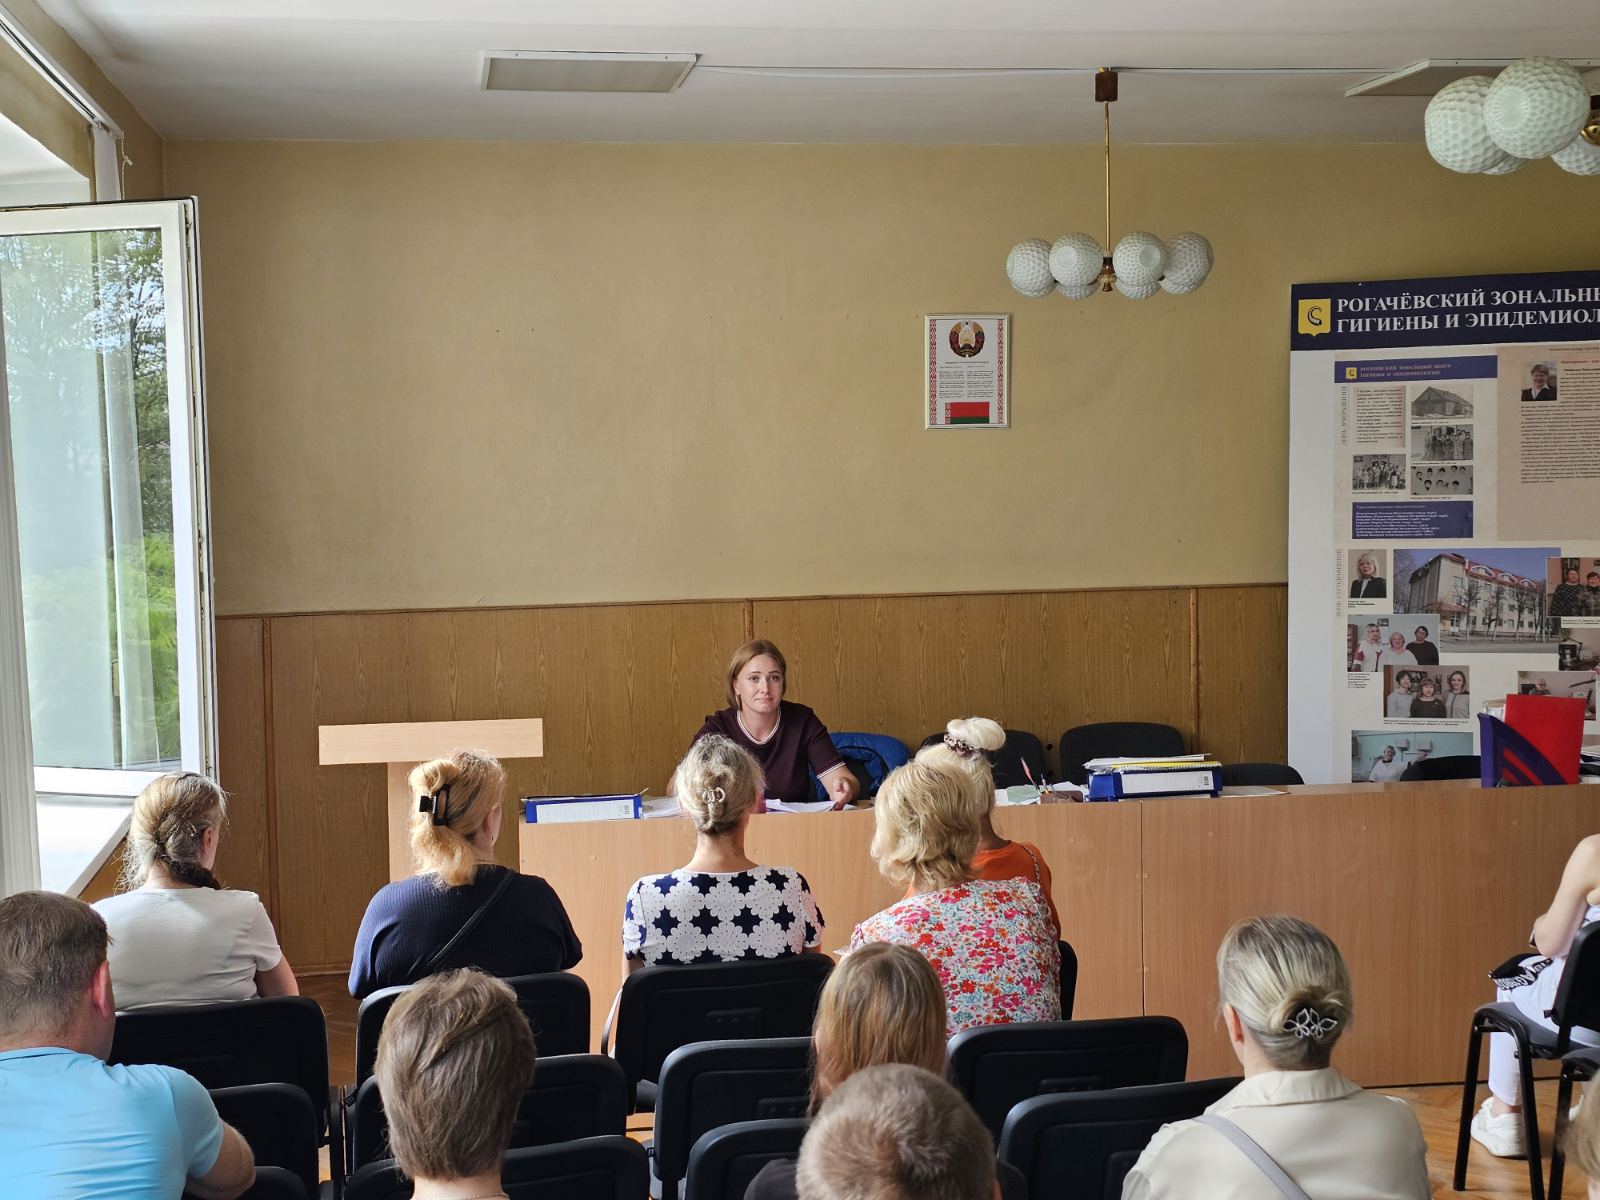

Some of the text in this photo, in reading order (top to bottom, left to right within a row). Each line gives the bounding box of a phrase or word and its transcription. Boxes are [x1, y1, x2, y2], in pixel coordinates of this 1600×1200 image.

[1336, 288, 1486, 313] РОГАЧЁВСКИЙ
[1336, 308, 1600, 333] ГИГИЕНЫ И ЭПИДЕМИОЛ
